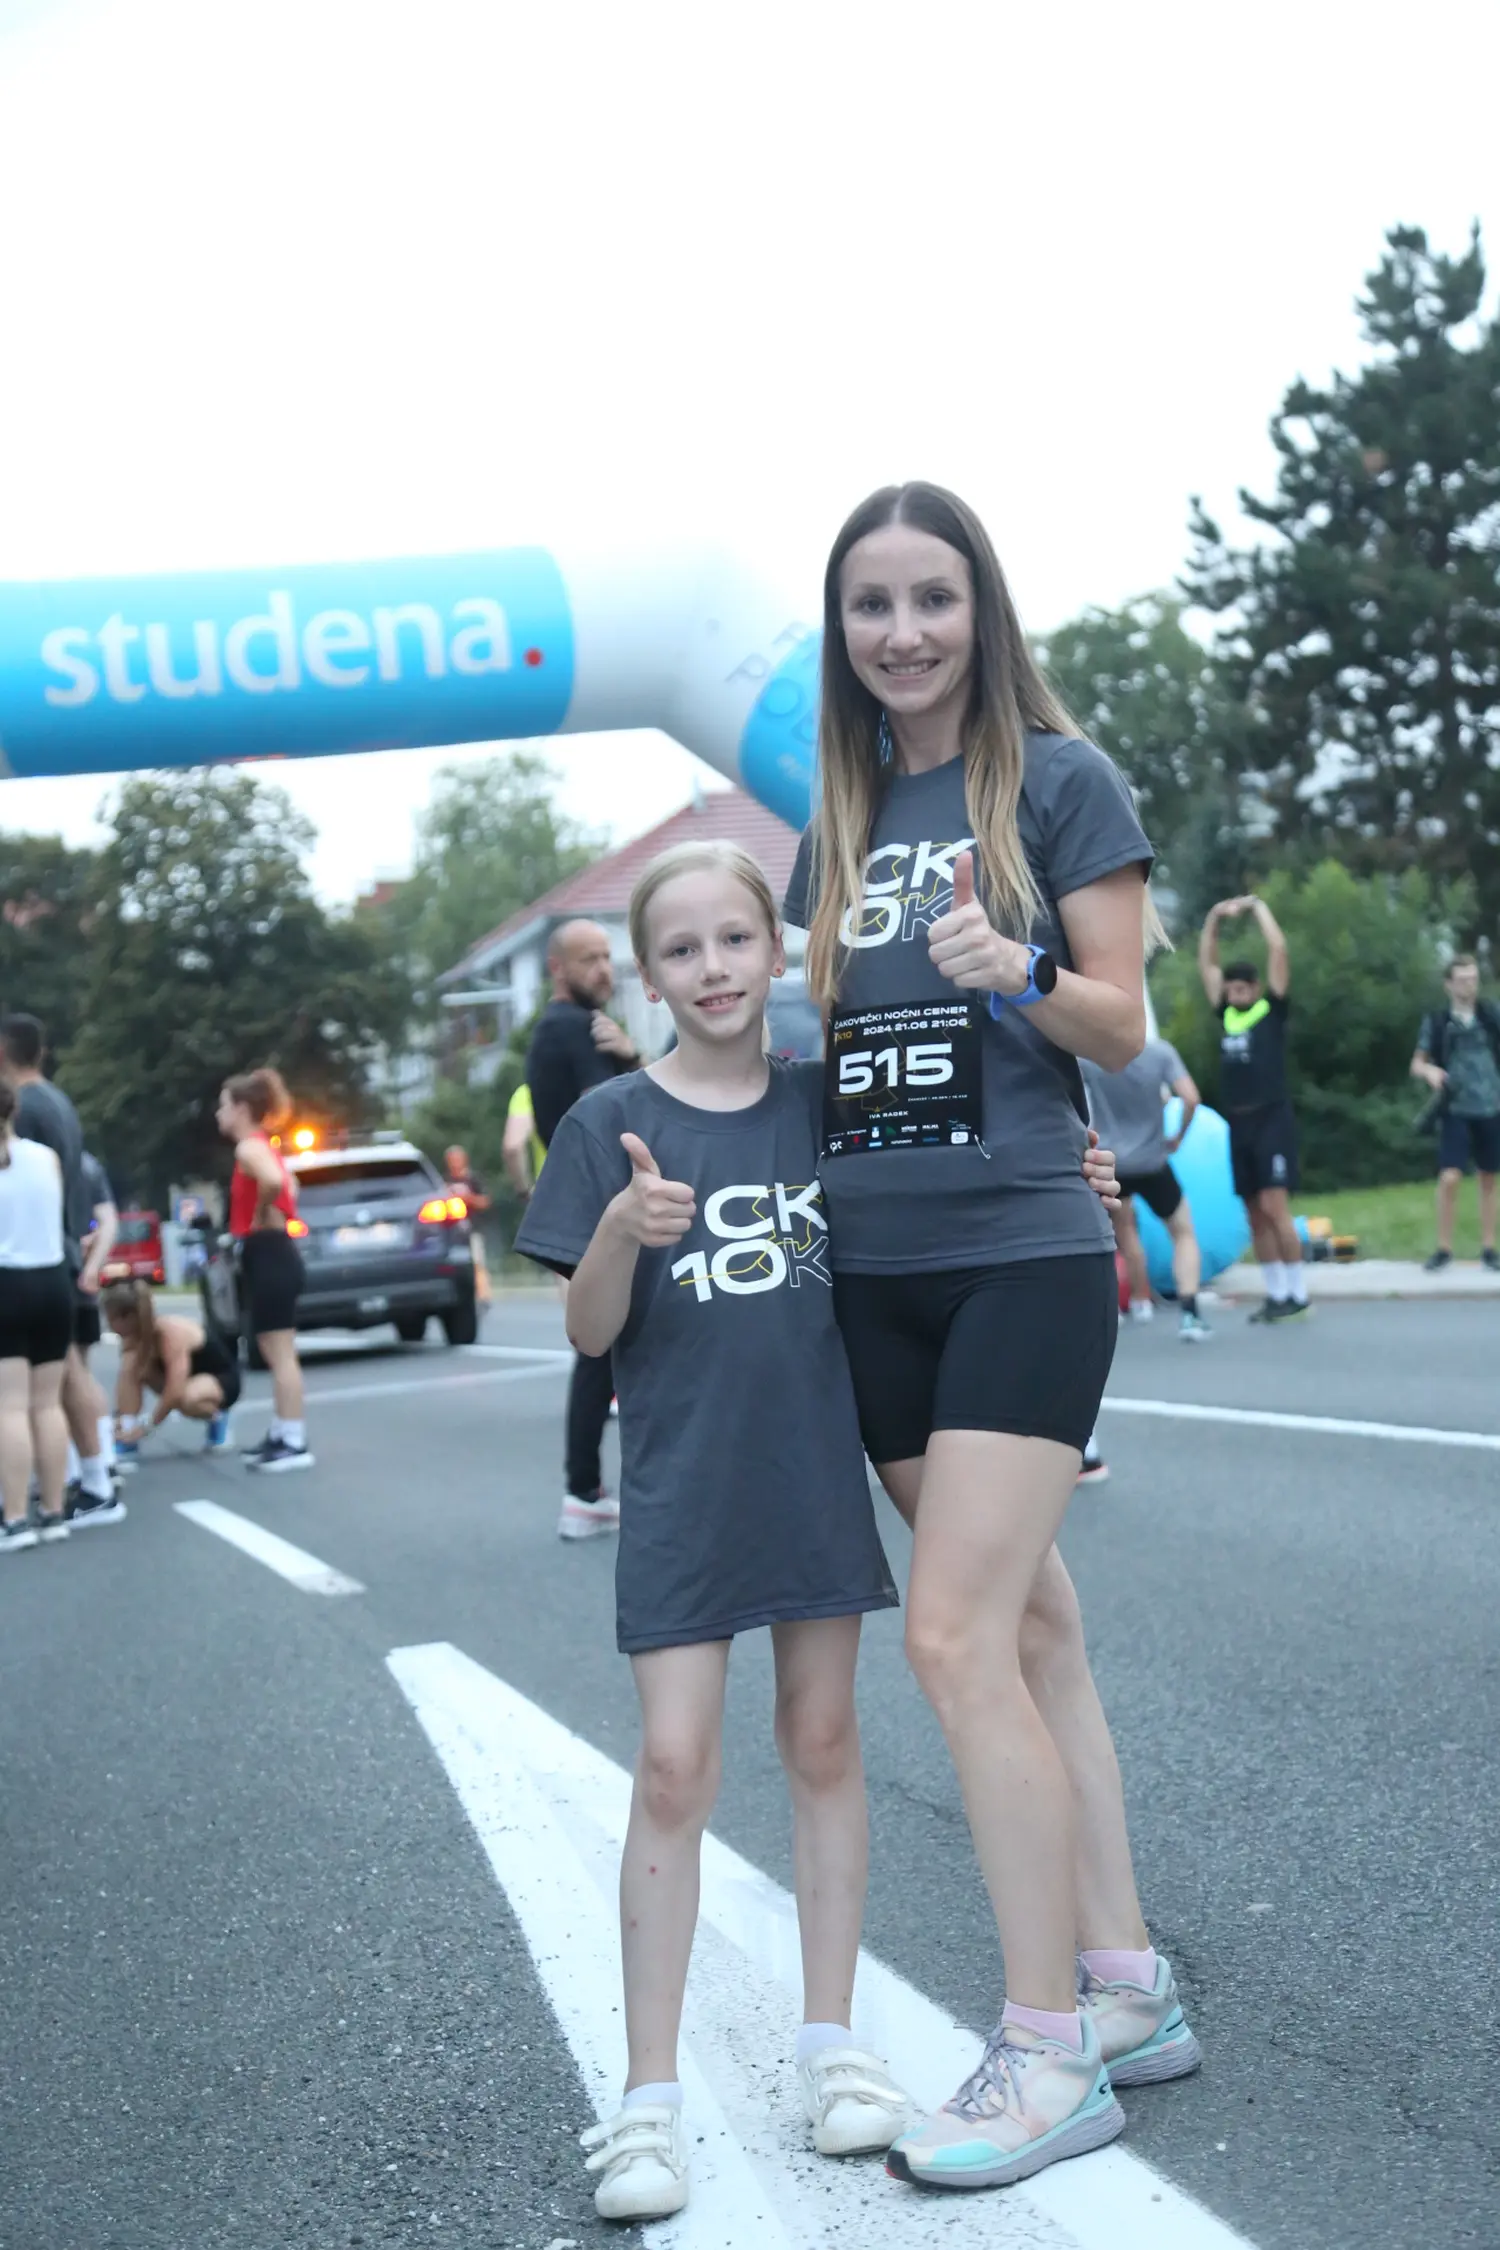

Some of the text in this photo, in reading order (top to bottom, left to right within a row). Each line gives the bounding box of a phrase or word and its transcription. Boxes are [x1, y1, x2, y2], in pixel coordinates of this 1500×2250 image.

[862, 838, 978, 896] CK
[863, 1017, 968, 1036] 2024 21.06 21:06
[923, 1005, 968, 1016] CENER
[838, 1042, 954, 1094] 515
[703, 1179, 829, 1240] CK
[671, 1235, 833, 1303] 10K
